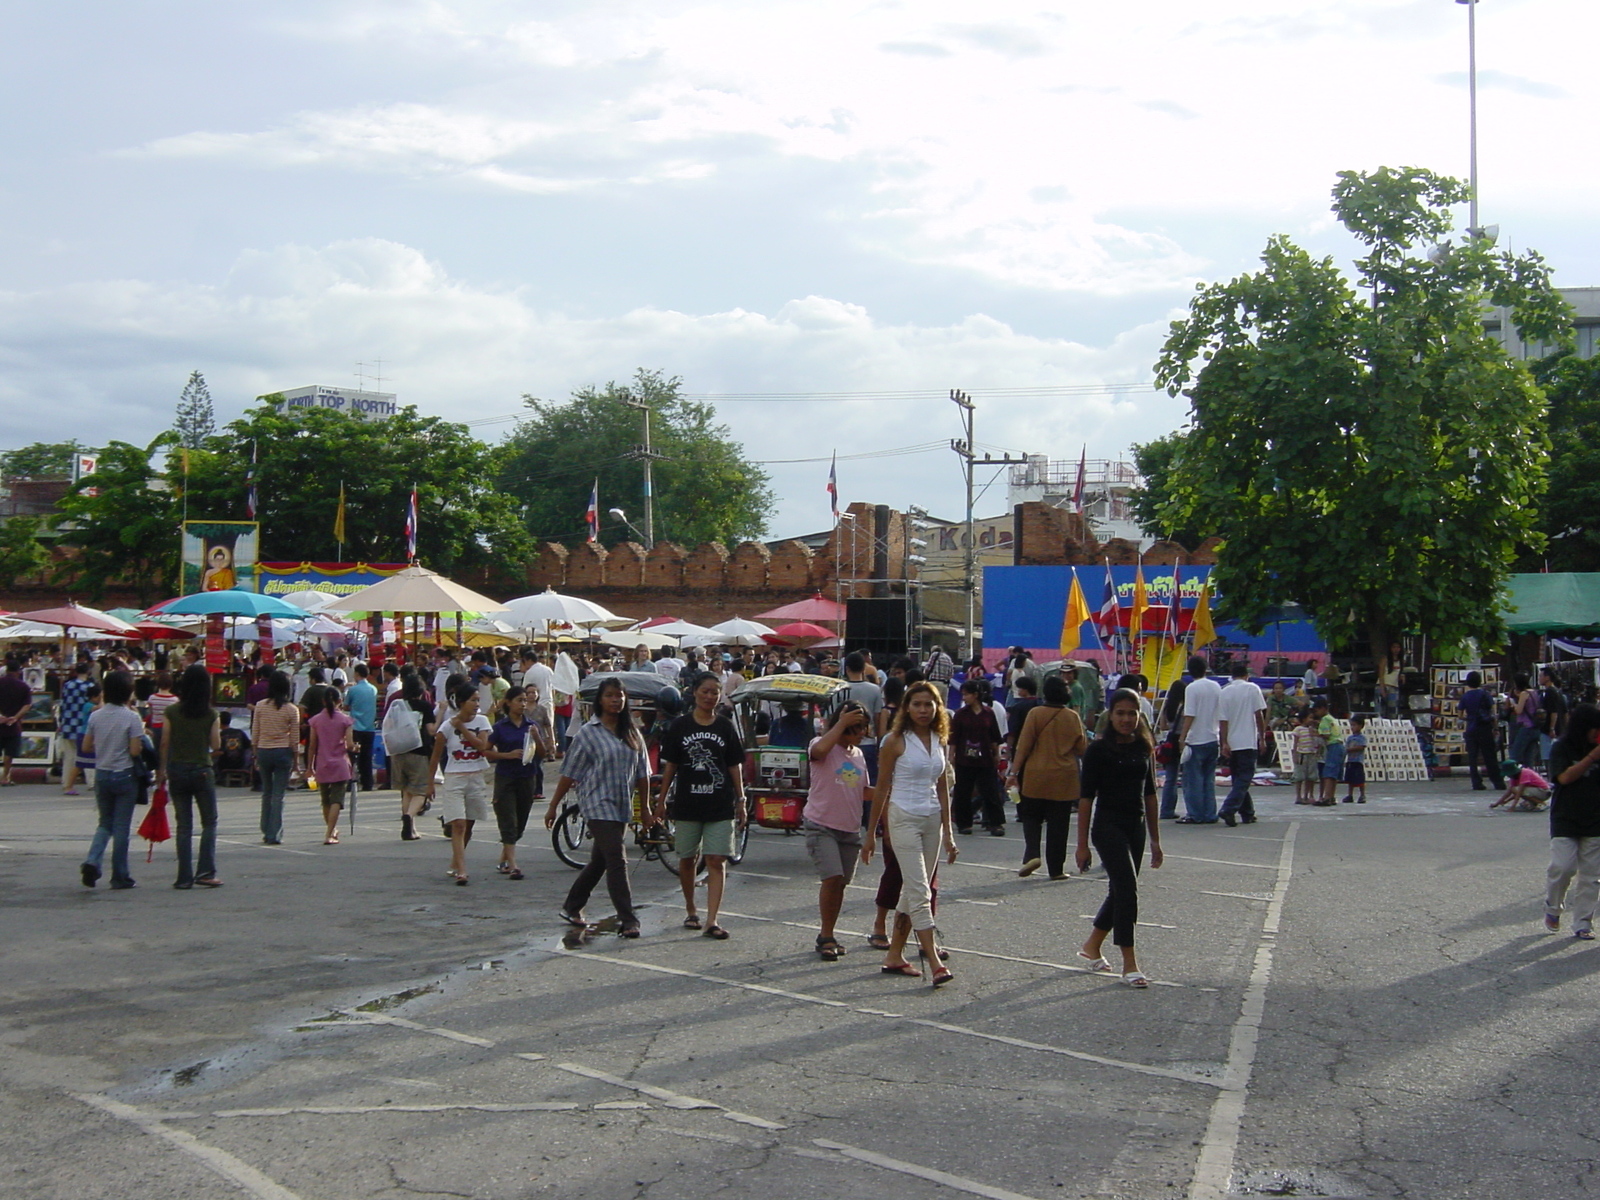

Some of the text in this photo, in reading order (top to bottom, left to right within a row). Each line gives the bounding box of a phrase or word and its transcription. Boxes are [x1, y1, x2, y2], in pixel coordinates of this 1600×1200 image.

[318, 394, 396, 415] TOP NORTH
[81, 460, 94, 471] 7
[939, 526, 1014, 550] Koda
[690, 784, 714, 794] LAOS
